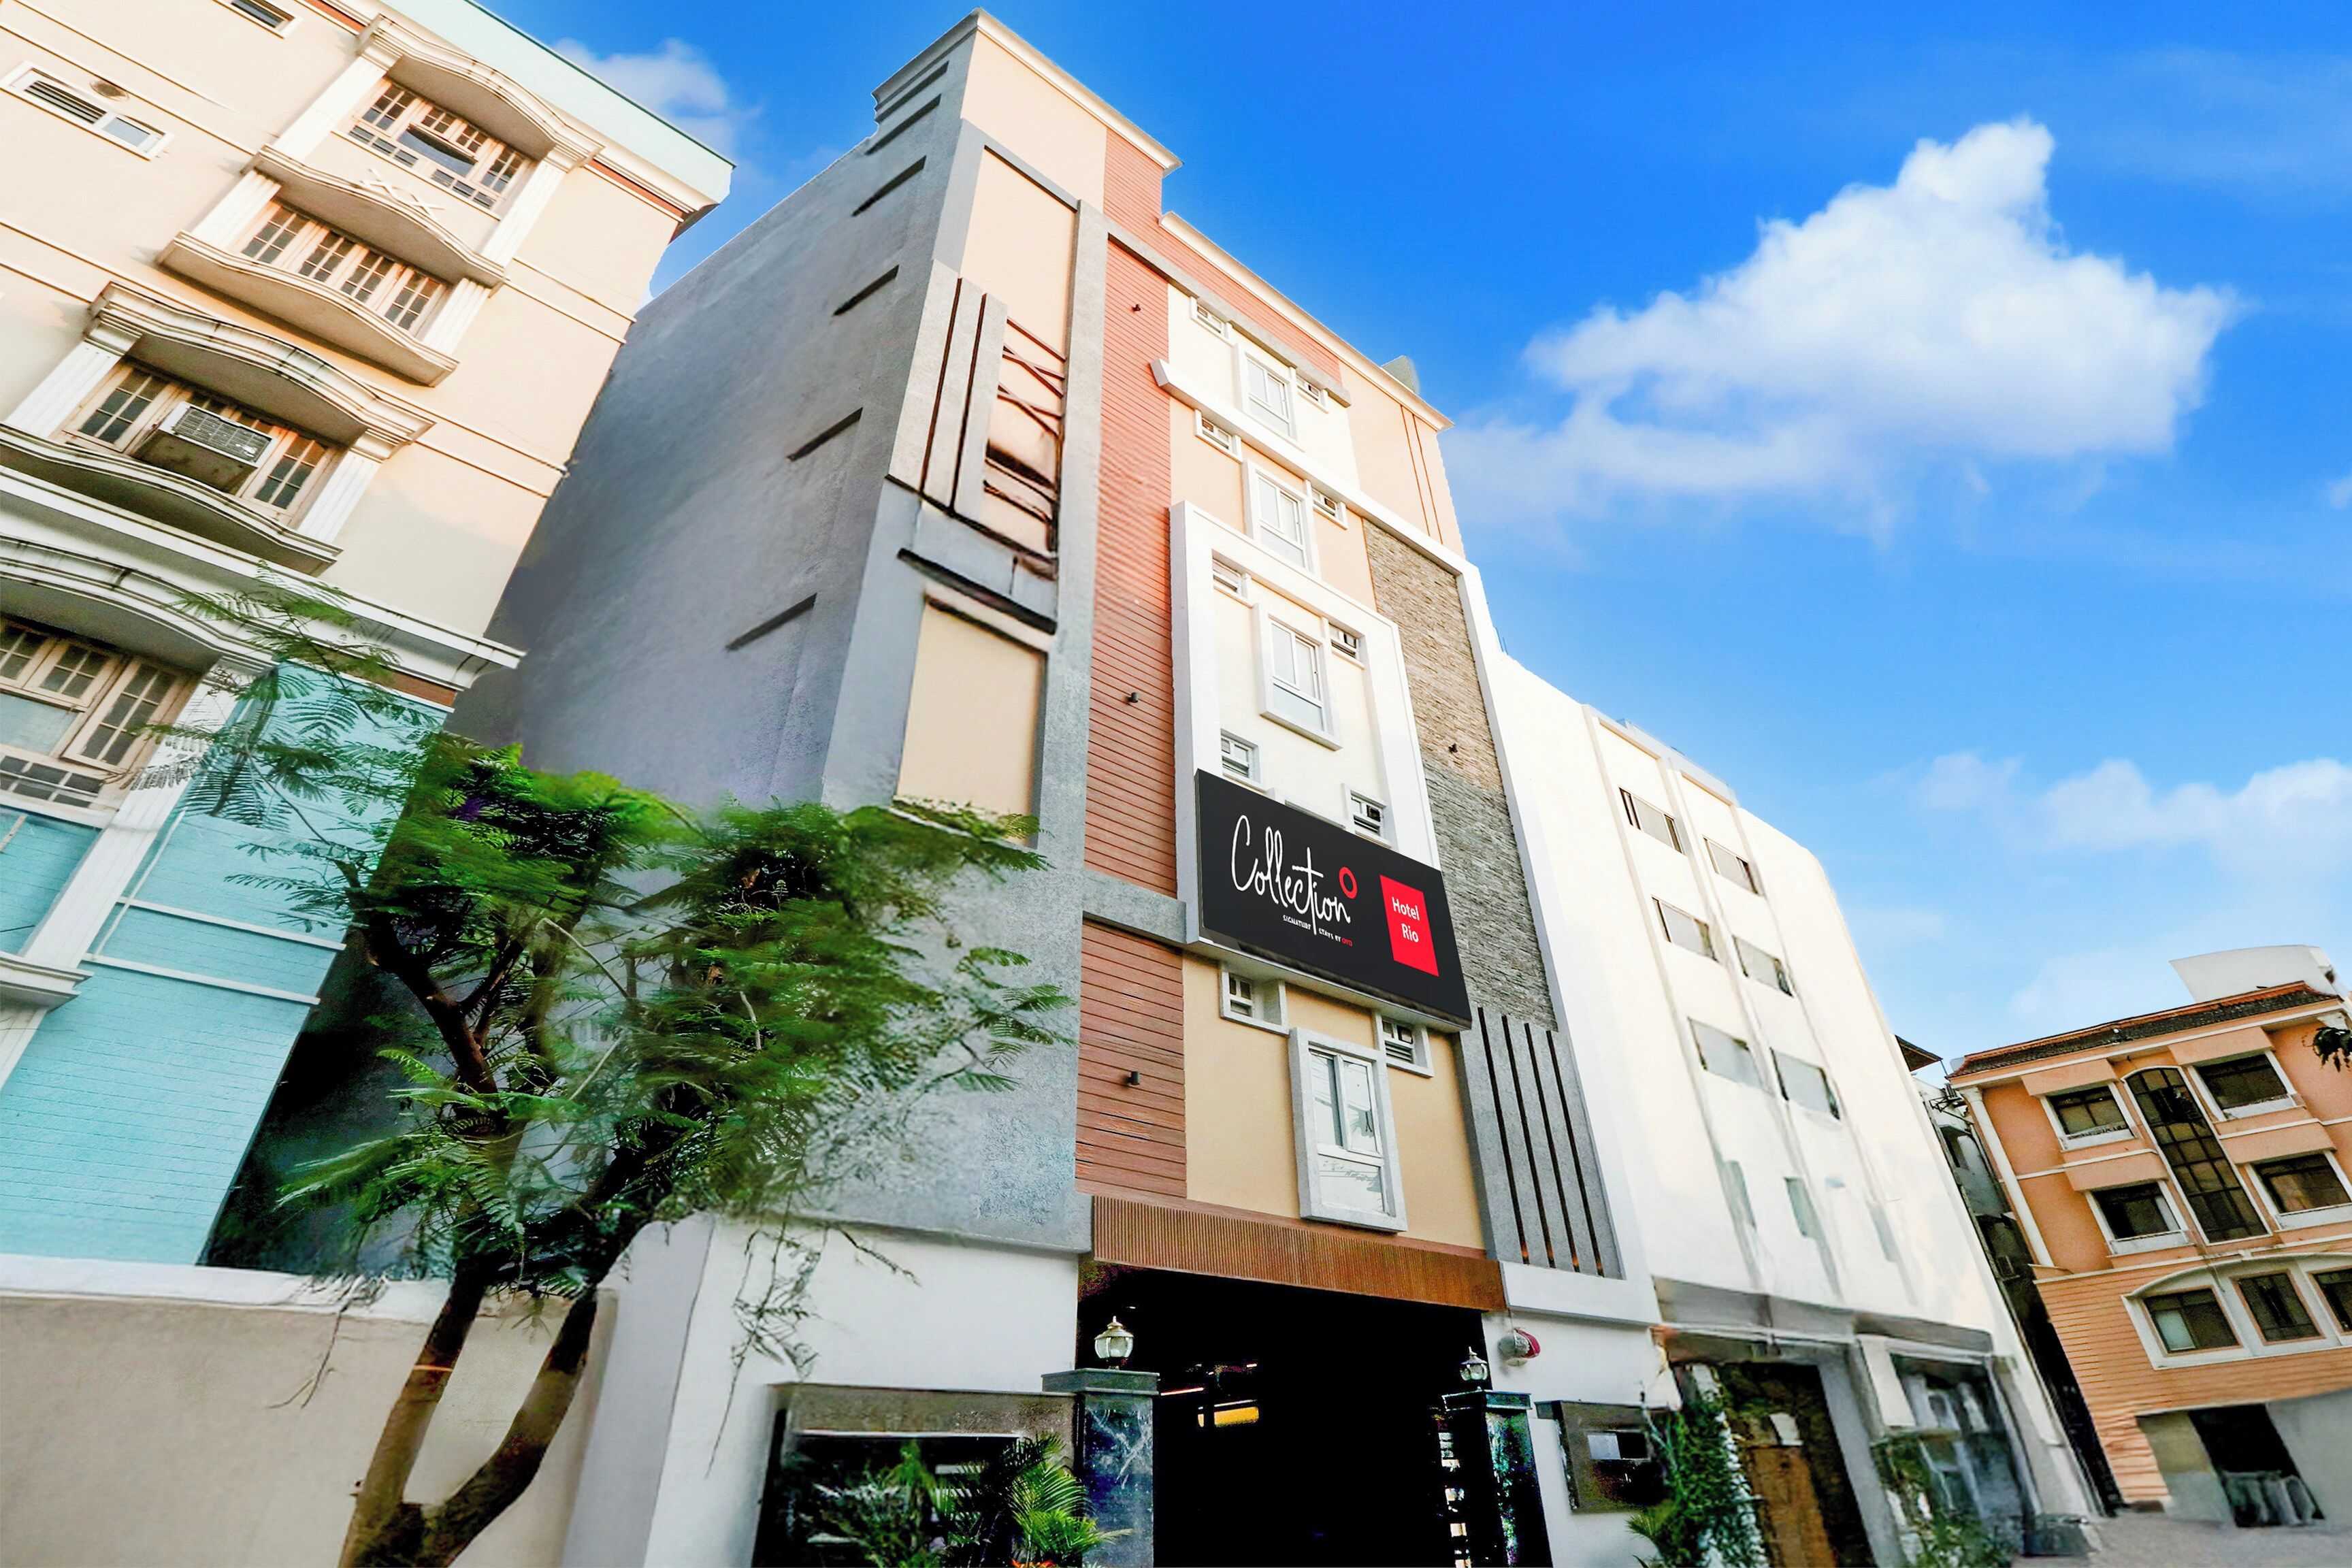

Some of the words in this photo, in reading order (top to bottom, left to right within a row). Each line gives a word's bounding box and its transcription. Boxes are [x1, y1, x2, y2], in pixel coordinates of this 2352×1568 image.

[1231, 815, 1351, 936] Collection
[1392, 896, 1420, 921] Hotel
[1401, 923, 1419, 943] Rio
